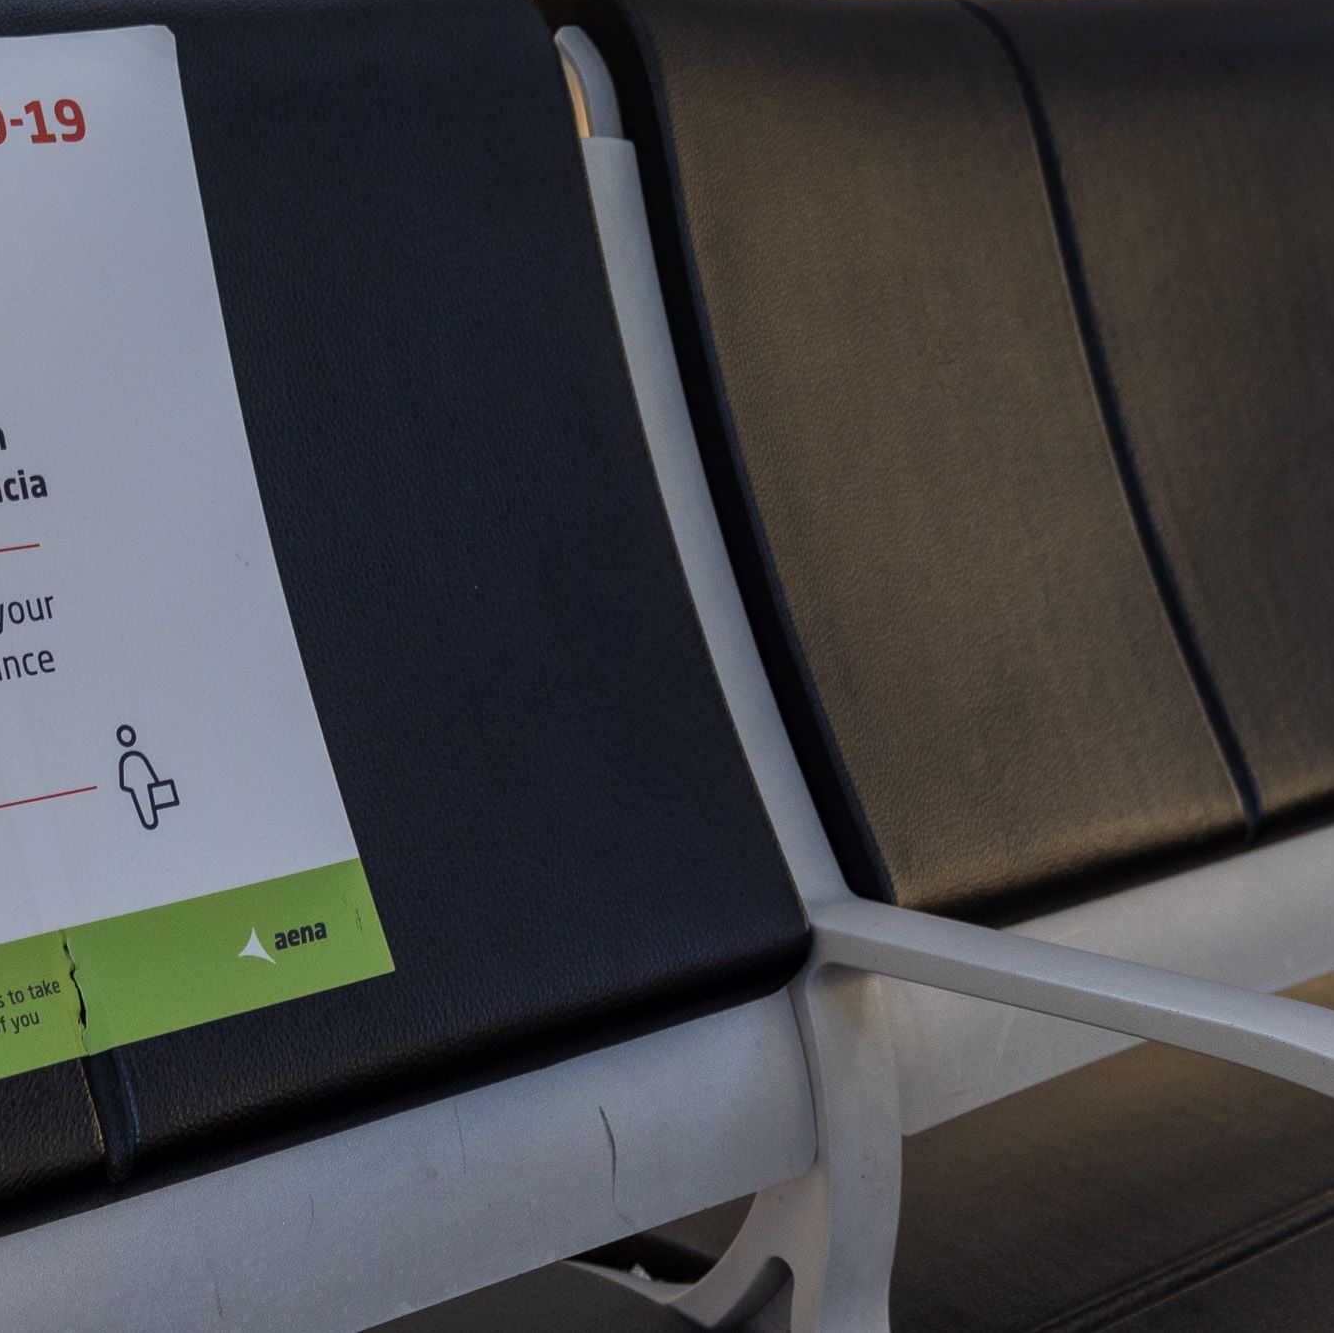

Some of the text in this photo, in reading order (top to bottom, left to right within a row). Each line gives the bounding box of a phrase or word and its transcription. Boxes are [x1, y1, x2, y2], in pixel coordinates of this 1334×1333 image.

[273, 919, 328, 952] aena
[7, 989, 26, 1006] to
[27, 978, 62, 1001] take
[10, 1010, 41, 1035] you
